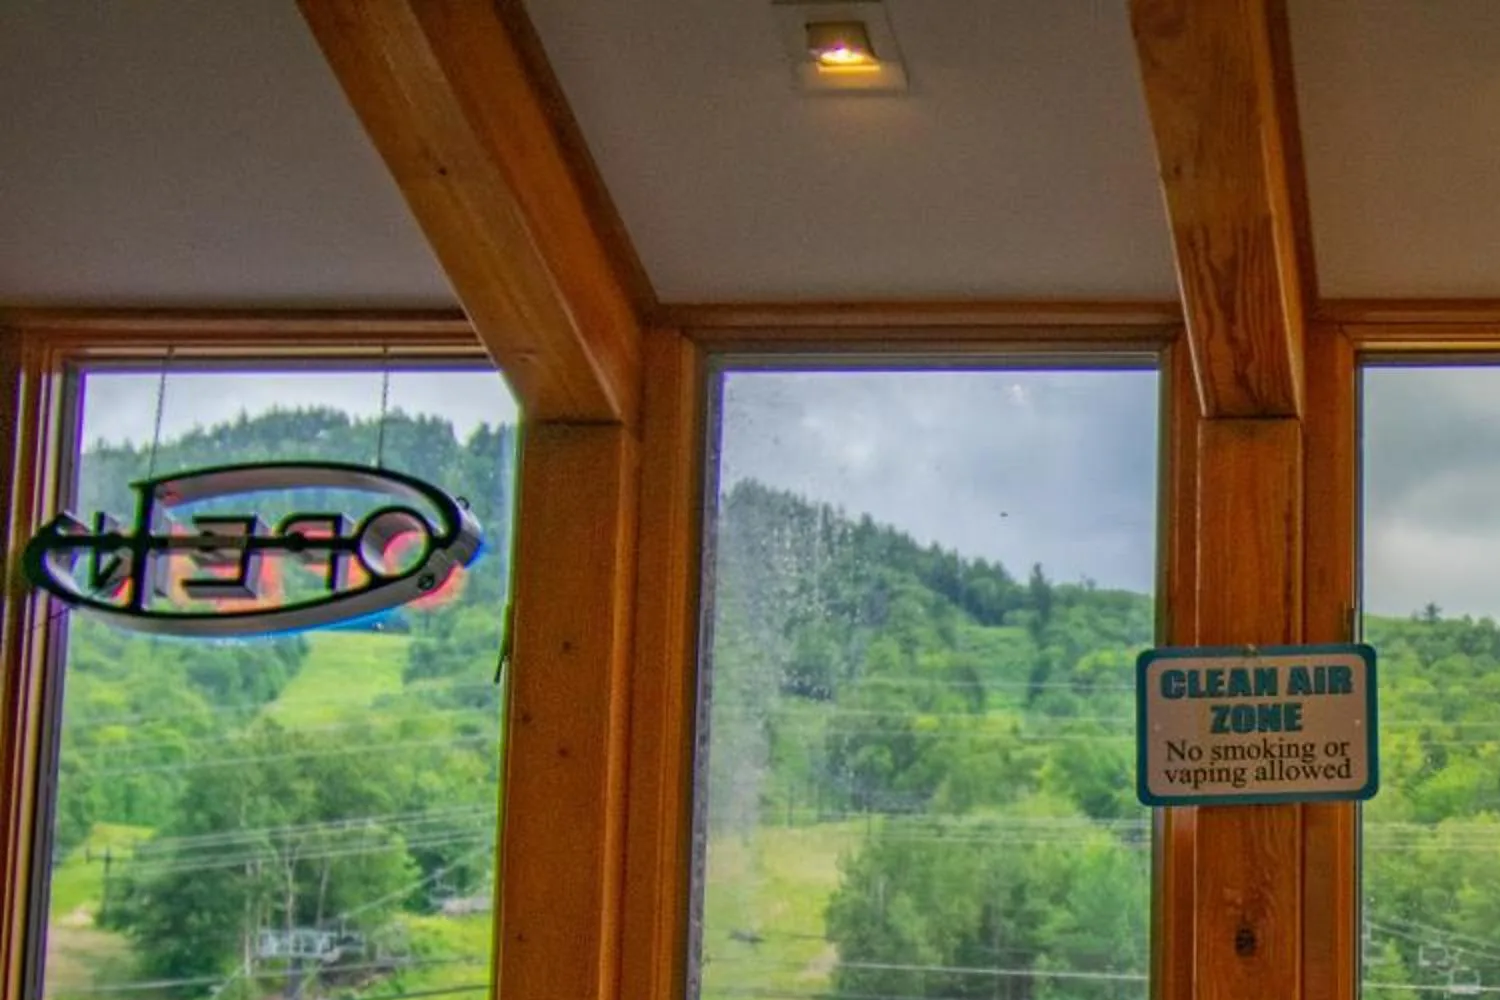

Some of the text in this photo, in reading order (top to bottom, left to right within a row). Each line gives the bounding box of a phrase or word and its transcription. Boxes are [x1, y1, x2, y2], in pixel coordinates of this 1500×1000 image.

[1160, 665, 1354, 699] CLEAN AIR
[1210, 703, 1302, 734] ZONE
[1166, 737, 1350, 764] No smoking or
[1164, 759, 1351, 788] vaping allowed
